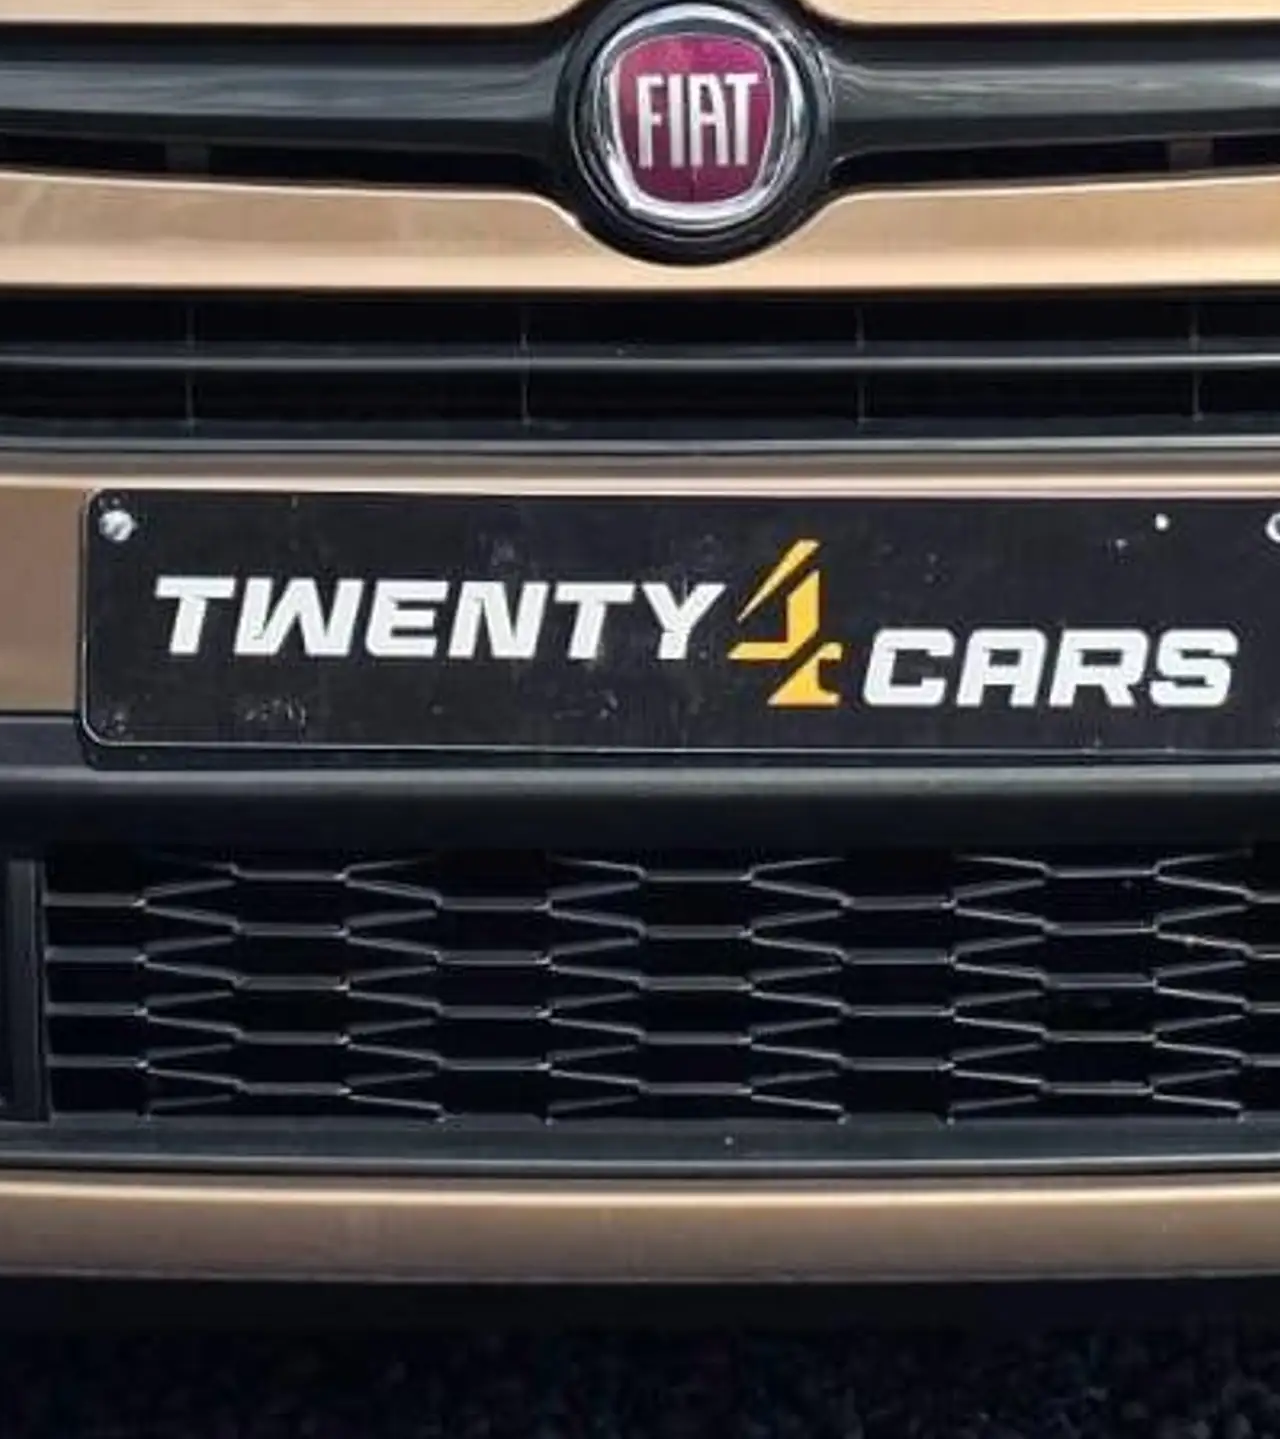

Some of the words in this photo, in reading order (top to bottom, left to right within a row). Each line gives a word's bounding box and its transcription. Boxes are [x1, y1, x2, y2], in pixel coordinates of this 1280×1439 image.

[636, 73, 759, 169] FIAT
[154, 576, 726, 661] TWENTY
[863, 628, 1239, 708] CARS
